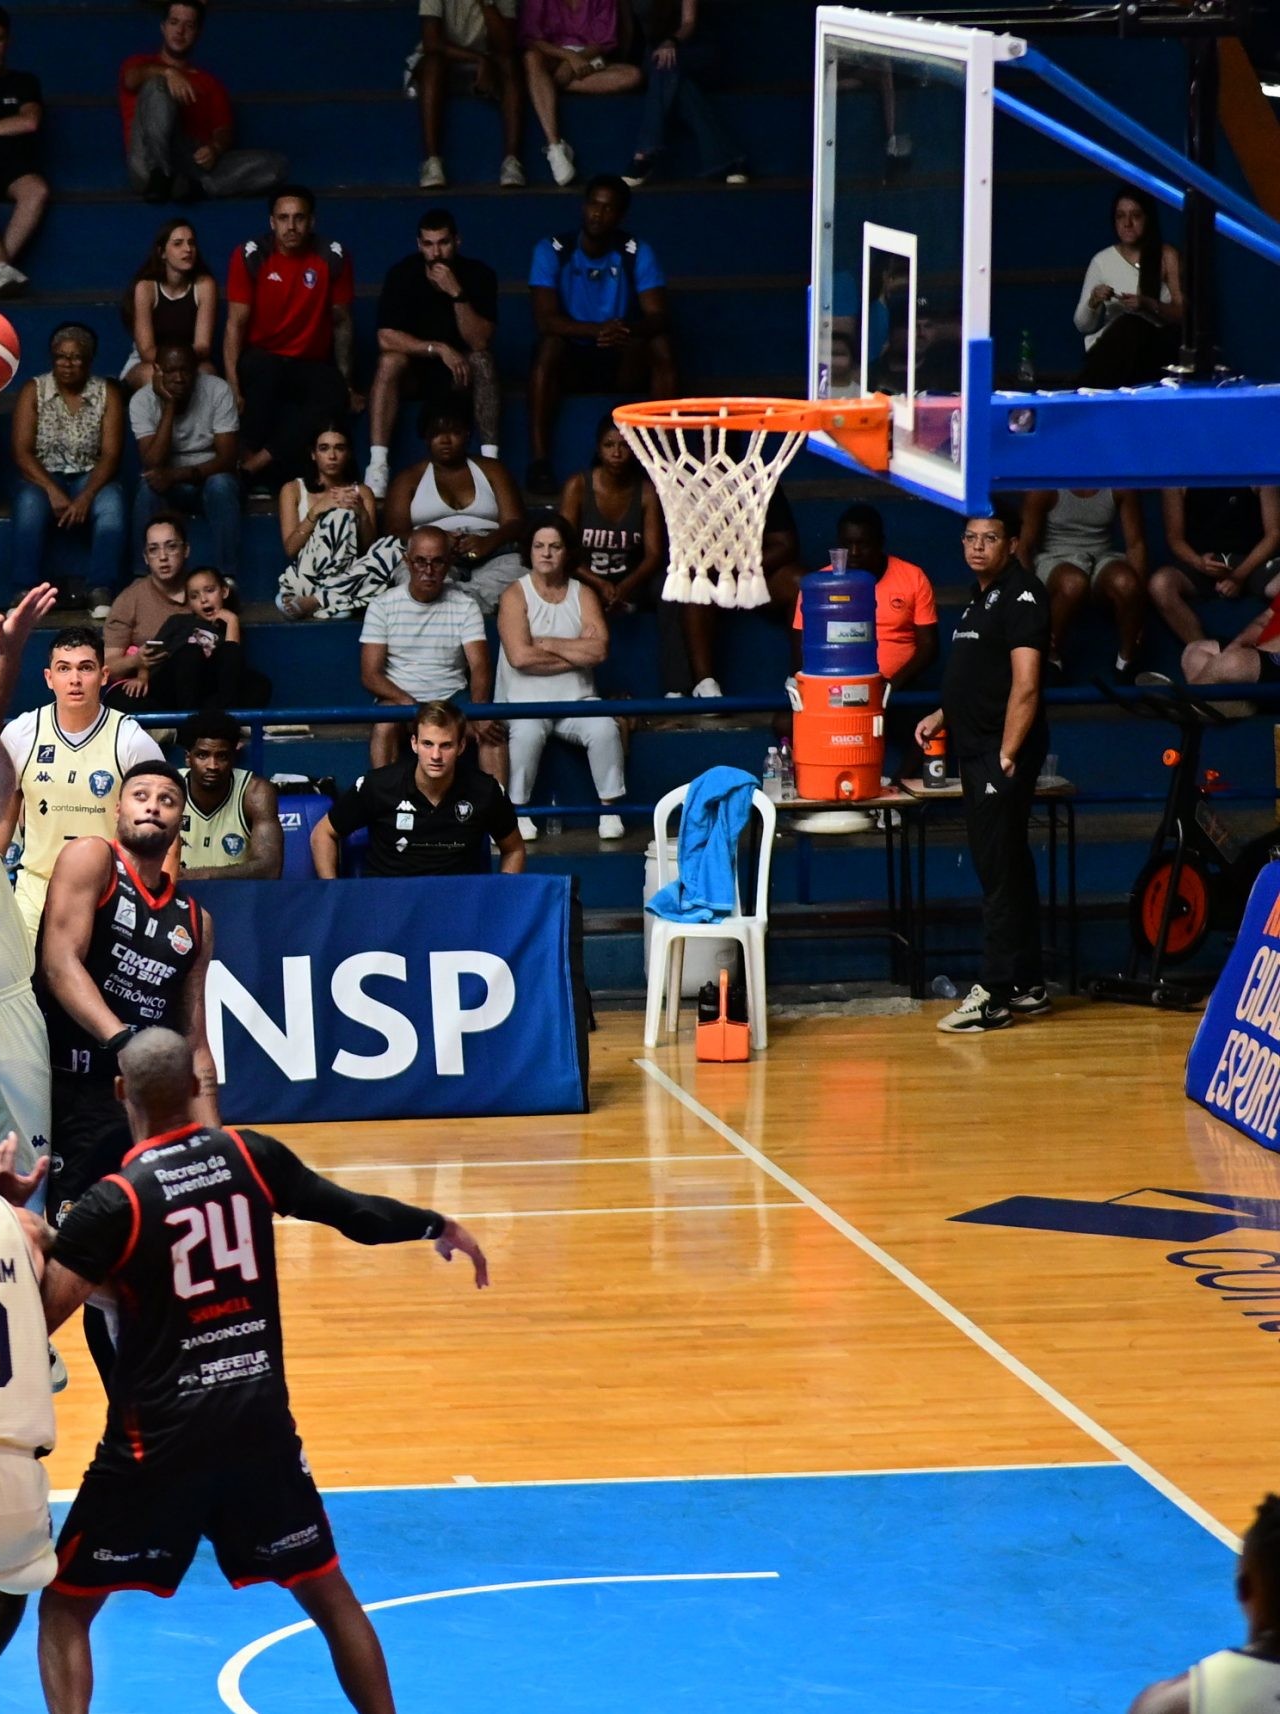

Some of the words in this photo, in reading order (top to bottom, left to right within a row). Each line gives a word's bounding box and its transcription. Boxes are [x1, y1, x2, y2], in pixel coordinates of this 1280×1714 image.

[51, 804, 106, 815] contasimples
[278, 813, 301, 826] ZZI
[205, 950, 516, 1084] NSP
[72, 1049, 91, 1073] 19
[154, 1161, 208, 1183] Recreio
[207, 1155, 226, 1169] da
[164, 1193, 259, 1299] 24
[200, 1350, 269, 1375] PREFEITUR
